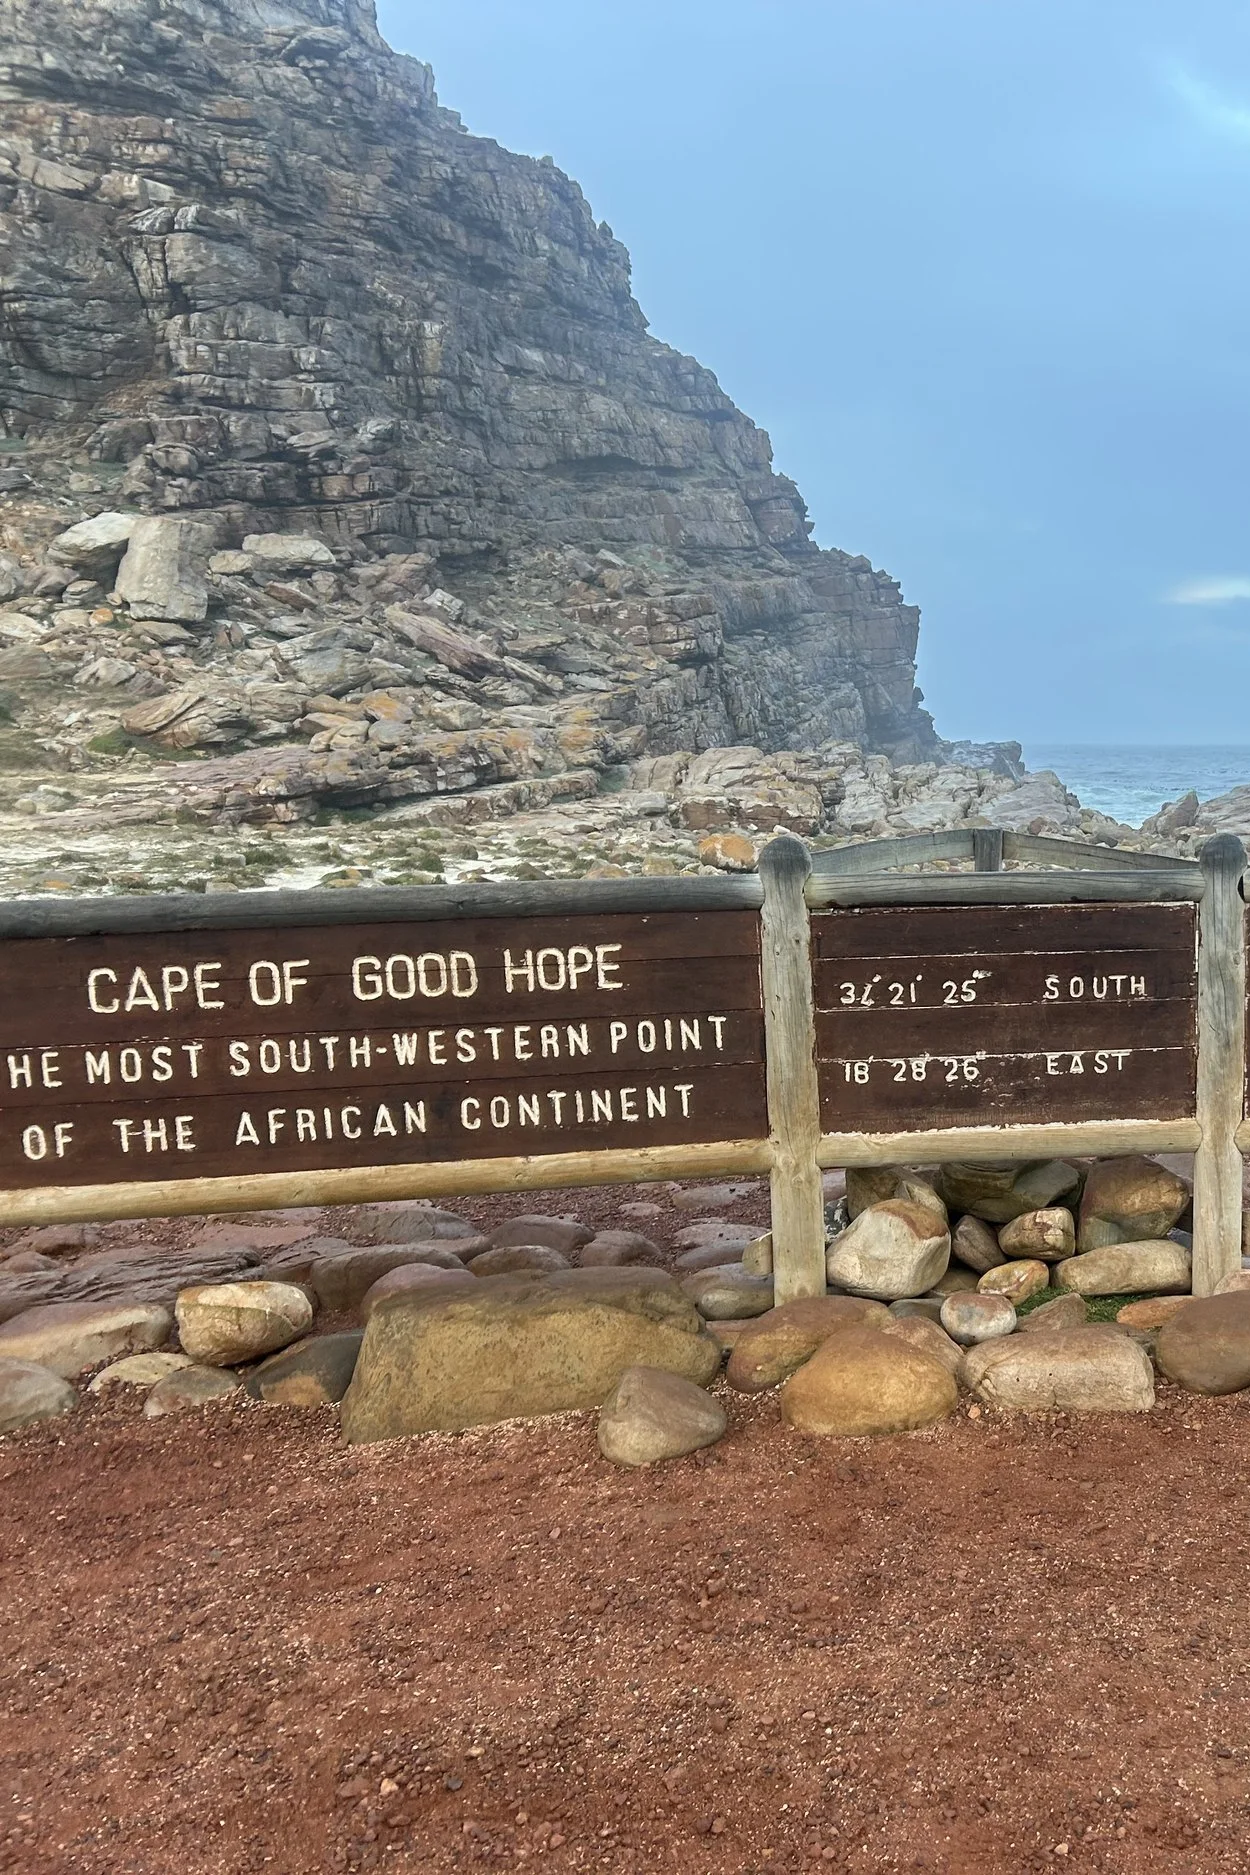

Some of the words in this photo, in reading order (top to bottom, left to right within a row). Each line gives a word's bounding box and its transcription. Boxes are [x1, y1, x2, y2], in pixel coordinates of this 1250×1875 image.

[87, 961, 225, 1014] CAPE
[248, 959, 310, 1006] OF
[351, 950, 479, 1001] GOOD
[503, 943, 624, 994] HOPE
[1043, 974, 1148, 1000] SOUTH
[85, 1043, 204, 1085] MOST
[228, 1022, 592, 1077] SOUTH-WESTERN
[609, 1015, 727, 1054] POINT
[1045, 1051, 1132, 1076] EAST
[22, 1122, 74, 1161] OF
[112, 1115, 197, 1153] THE
[235, 1100, 427, 1146] AFRICAN
[460, 1084, 694, 1130] CONTINENT
